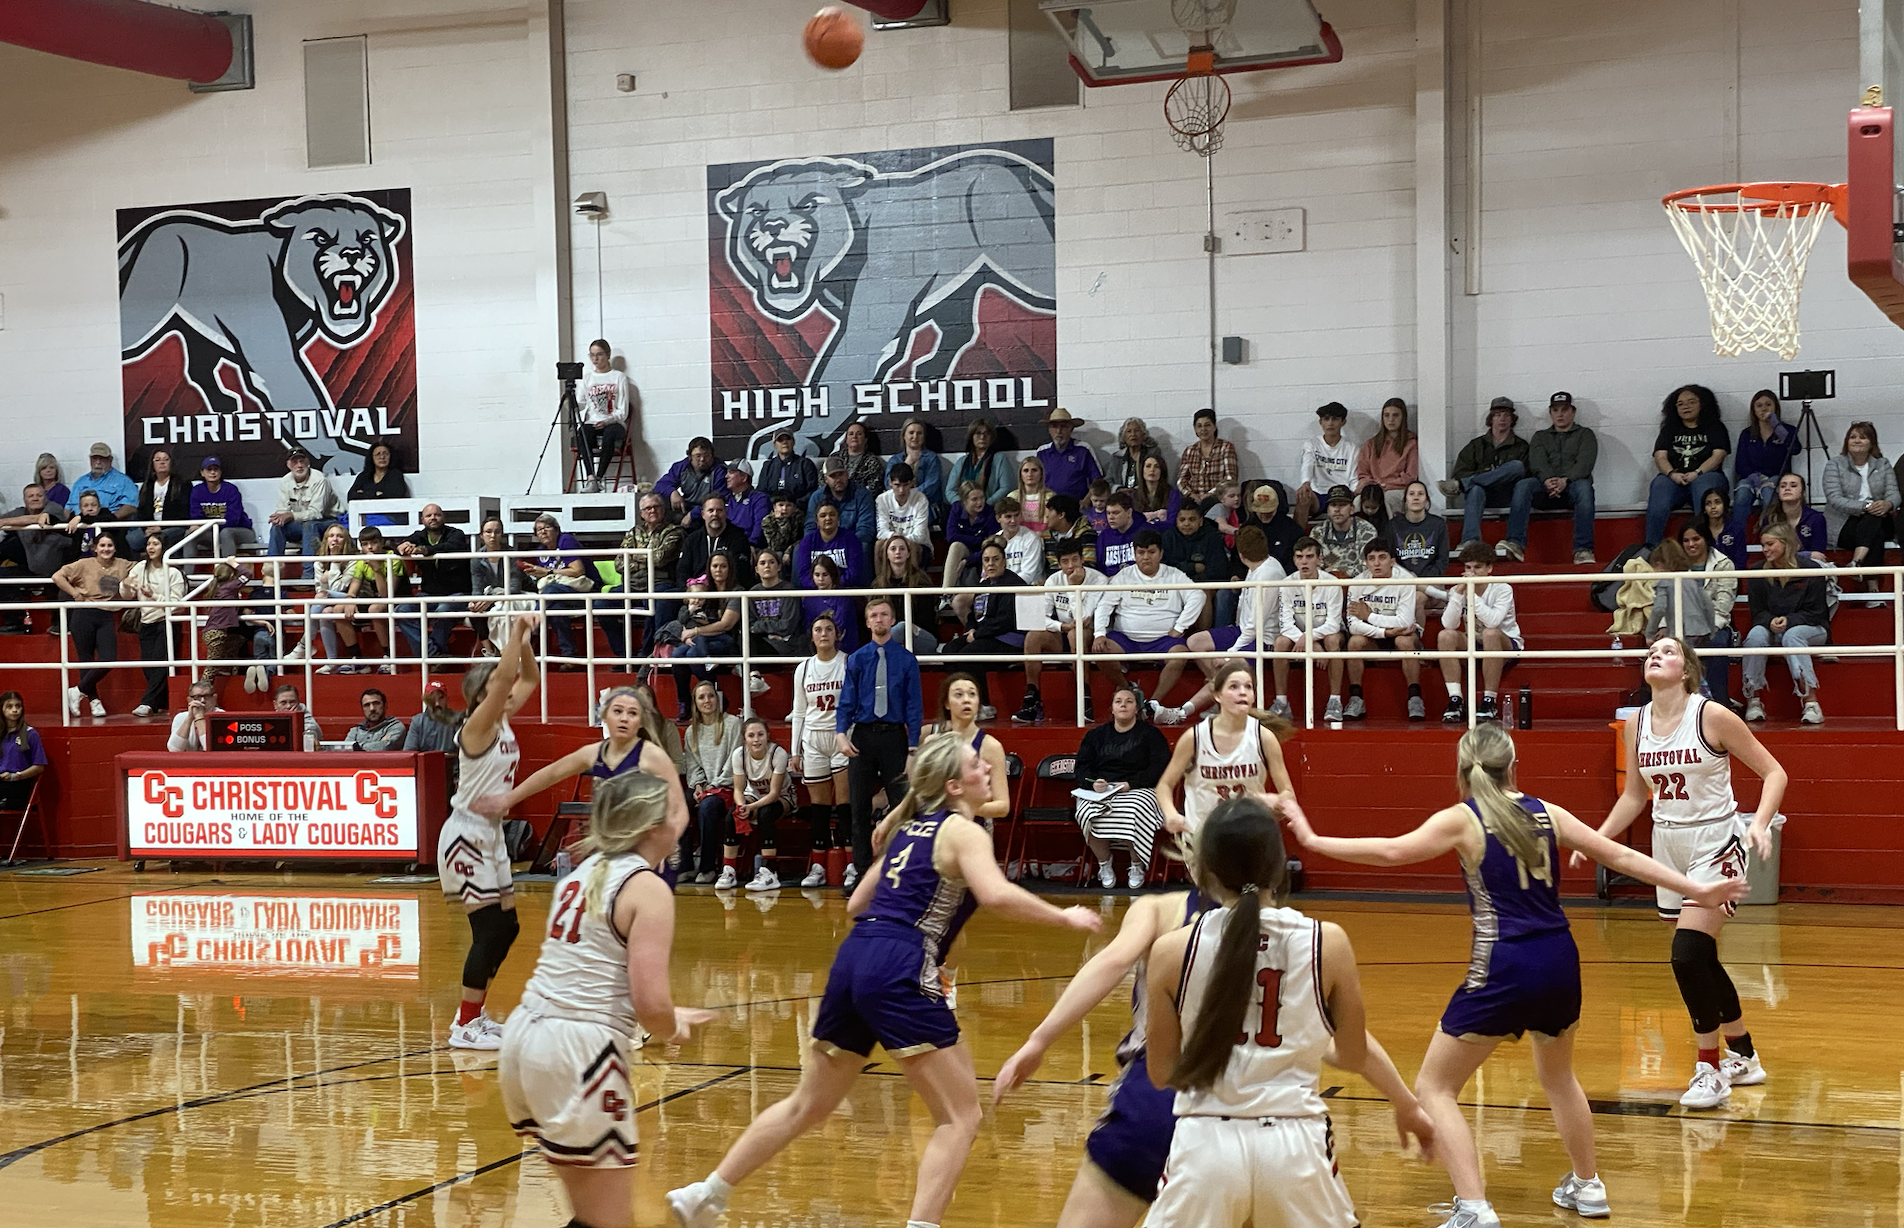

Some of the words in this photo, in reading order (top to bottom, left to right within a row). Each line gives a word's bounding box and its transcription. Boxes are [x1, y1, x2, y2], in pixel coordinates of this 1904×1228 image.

[721, 386, 829, 421] HIGH
[853, 377, 1049, 415] SCHOOL
[141, 406, 402, 445] CHRISTOVAL
[236, 735, 266, 744] BONUS
[239, 723, 262, 732] POSS
[192, 781, 347, 811] CHRISTOVAL
[1651, 772, 1690, 801] 22
[231, 813, 264, 821] HOME
[269, 813, 283, 821] OF
[288, 813, 309, 821] THE
[144, 823, 233, 845] COUGARS
[238, 827, 248, 840] &
[252, 824, 300, 845] LADY
[307, 824, 399, 846] COUGARS
[885, 842, 915, 889] 4
[550, 881, 586, 944] 21
[1235, 967, 1286, 1048] 1
